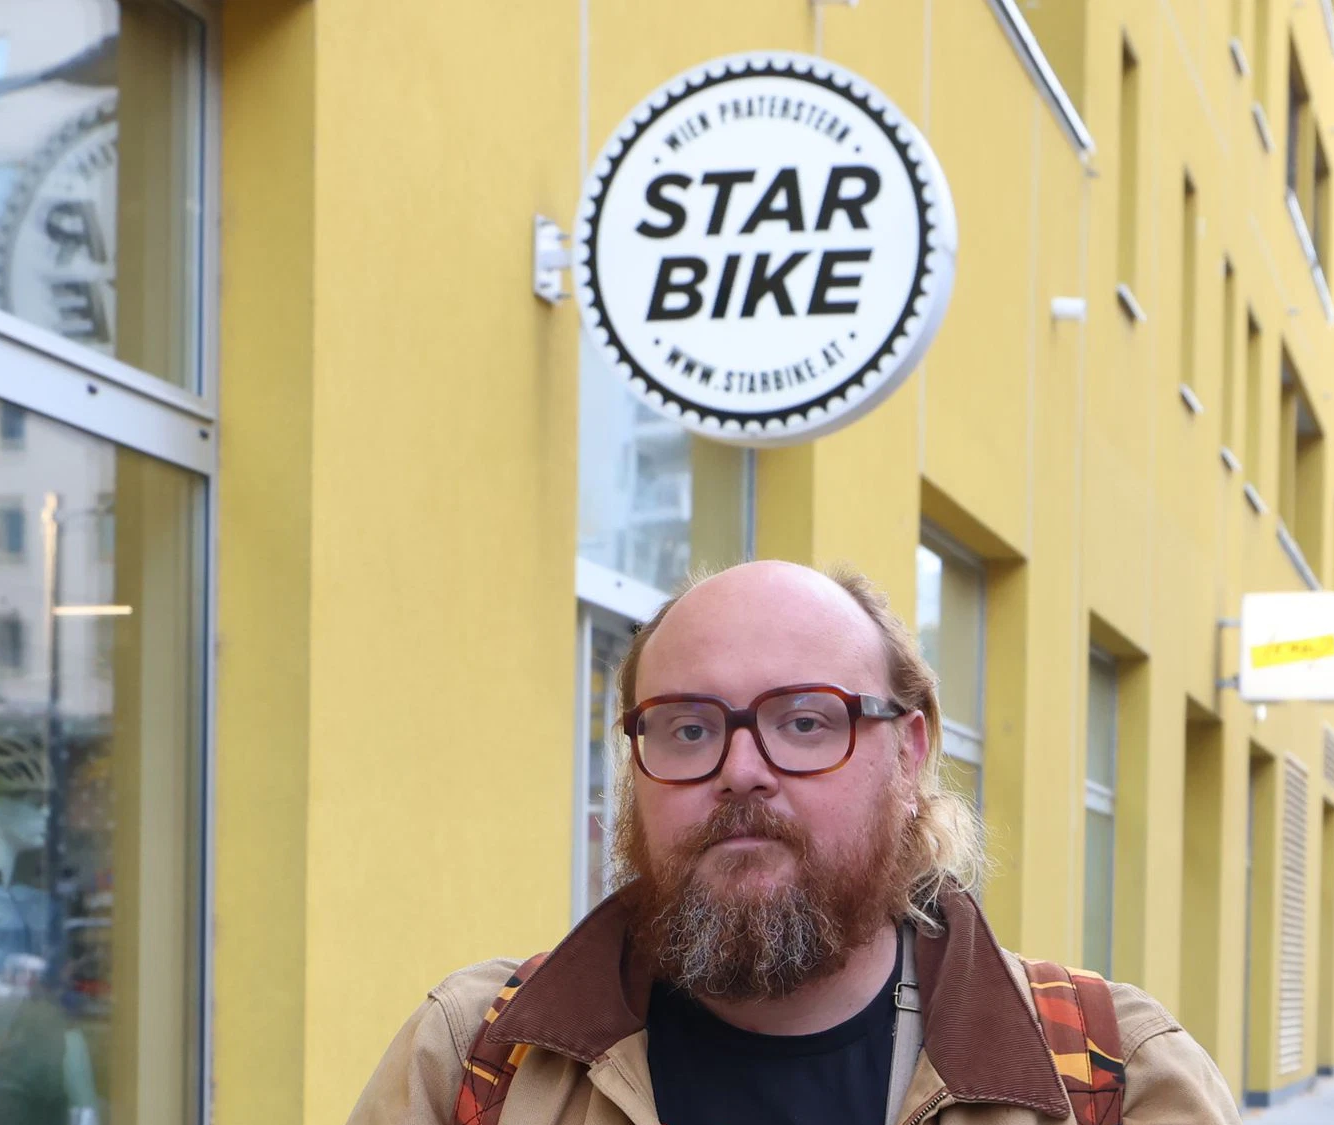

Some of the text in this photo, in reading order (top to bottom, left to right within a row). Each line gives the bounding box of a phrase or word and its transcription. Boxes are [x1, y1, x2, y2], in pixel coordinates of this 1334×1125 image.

[663, 94, 853, 153] WIEN PRATERSTERN
[634, 164, 882, 239] STAR
[644, 247, 875, 323] BIKE
[663, 340, 846, 394] WWW.STARBIKE.AT
